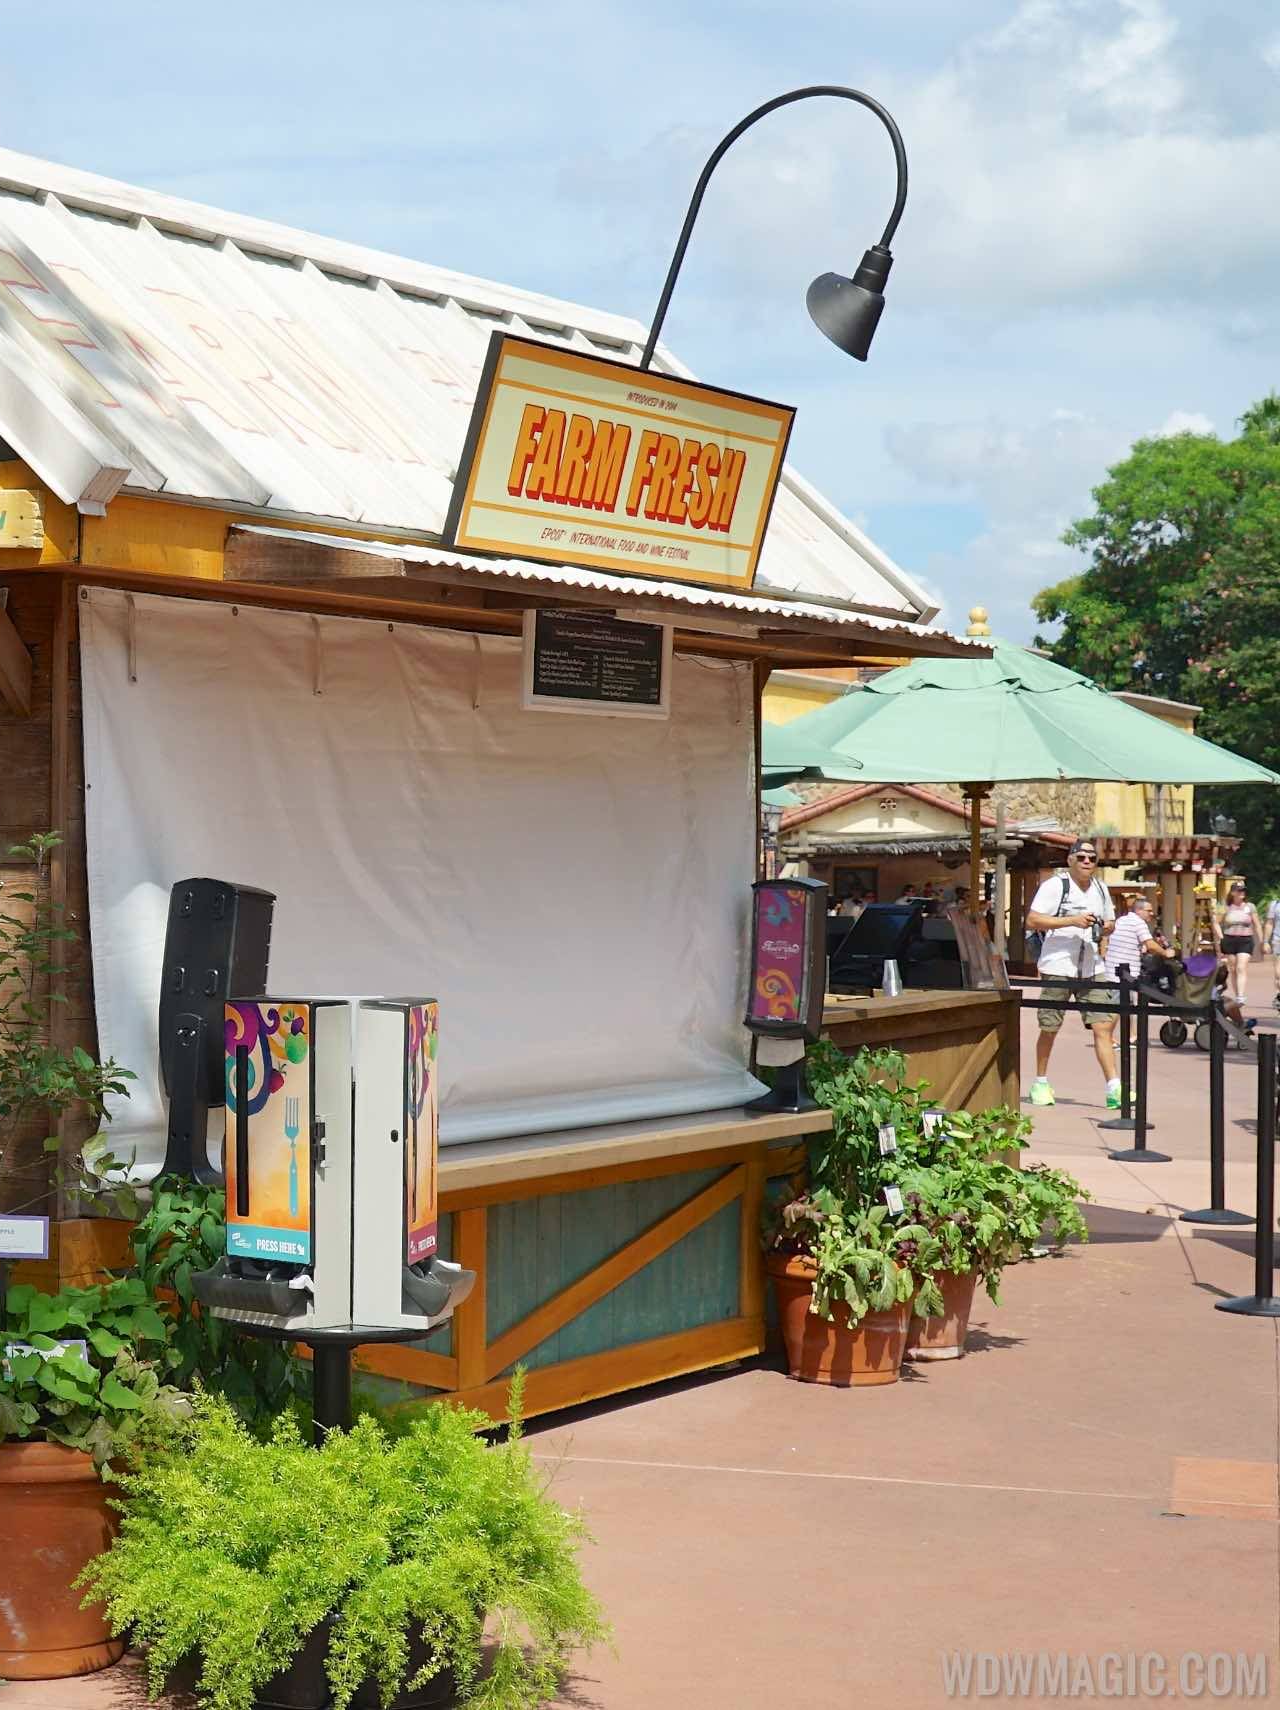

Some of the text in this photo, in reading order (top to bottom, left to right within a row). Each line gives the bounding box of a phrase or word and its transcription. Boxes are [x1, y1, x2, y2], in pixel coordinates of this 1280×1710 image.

[507, 404, 746, 533] FARM FRESH
[570, 532, 616, 549] INTERNATIONAL
[618, 539, 635, 552] FOOD
[635, 543, 649, 554] AND
[650, 545, 666, 557] WINE
[666, 547, 690, 560] FESTIVAL
[256, 1239, 278, 1252] PRESS
[279, 1241, 297, 1254] HERE
